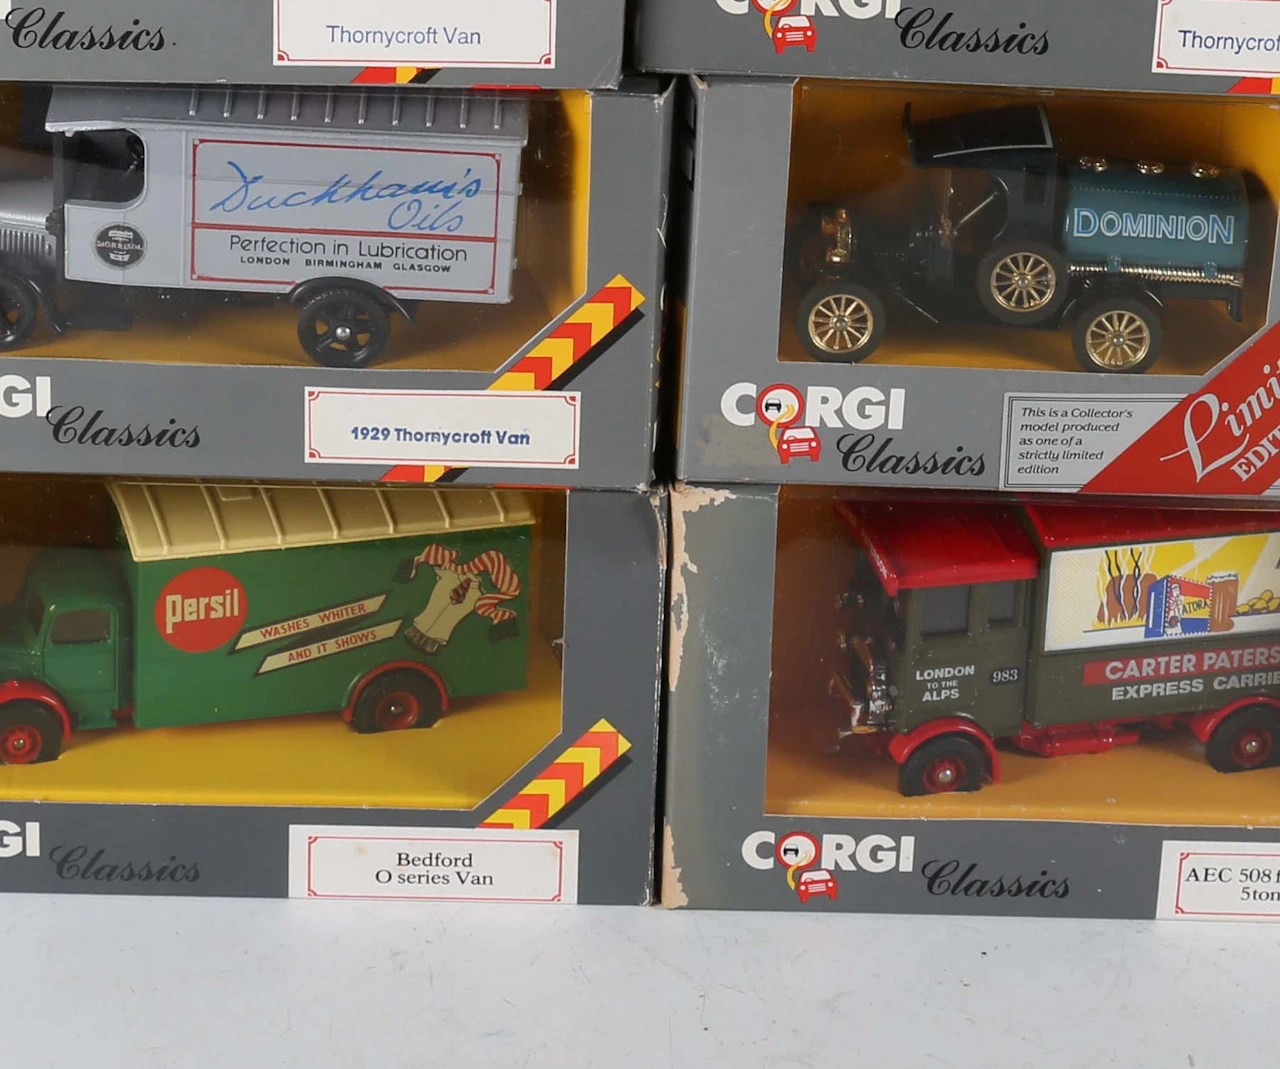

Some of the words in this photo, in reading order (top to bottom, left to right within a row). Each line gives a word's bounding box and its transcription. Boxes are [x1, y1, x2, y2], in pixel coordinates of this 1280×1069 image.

[5, 7, 165, 53] Classics
[325, 24, 440, 48] Thornycroft
[444, 27, 482, 46] Van
[896, 7, 1050, 56] Classics
[387, 198, 464, 232] Oils
[1073, 206, 1235, 245] DOMINION
[229, 235, 329, 255] Perfection
[332, 239, 348, 256] in
[358, 239, 468, 262] Lubrication
[240, 256, 291, 266] LONDON
[305, 258, 383, 271] BIRMINGHAM
[392, 262, 452, 273] GLASGOW
[720, 381, 905, 429] CORGI
[45, 404, 202, 449] Classics
[350, 425, 391, 445] 1929
[394, 425, 493, 449] Thornycroft
[494, 427, 531, 446] Van
[1020, 421, 1060, 433] model
[1062, 421, 1119, 435] produced
[836, 433, 986, 476] Classics
[1018, 450, 1059, 463] strictly
[1062, 450, 1103, 461] limited
[1017, 463, 1059, 475] edition
[1181, 597, 1210, 616] ATORA
[260, 618, 310, 640] WASHES
[318, 604, 366, 624] WHITER
[288, 647, 312, 663] AND
[317, 642, 328, 654] IT
[336, 630, 377, 649] SHOWS
[916, 665, 975, 681] LONDON
[992, 668, 1018, 683] 983
[1105, 651, 1197, 680] CARTER
[922, 688, 960, 702] ALPS
[927, 681, 938, 689] TO
[940, 680, 958, 688] THE
[1111, 678, 1204, 701] EXPRESS
[396, 852, 473, 869] Bedford
[741, 829, 915, 873] CORGI
[49, 845, 201, 884] Classics
[1184, 867, 1232, 885] AEC
[1238, 867, 1272, 885] 508
[375, 869, 392, 886] O
[397, 869, 451, 886] series
[454, 870, 495, 887] Van
[921, 859, 1071, 899] Classics
